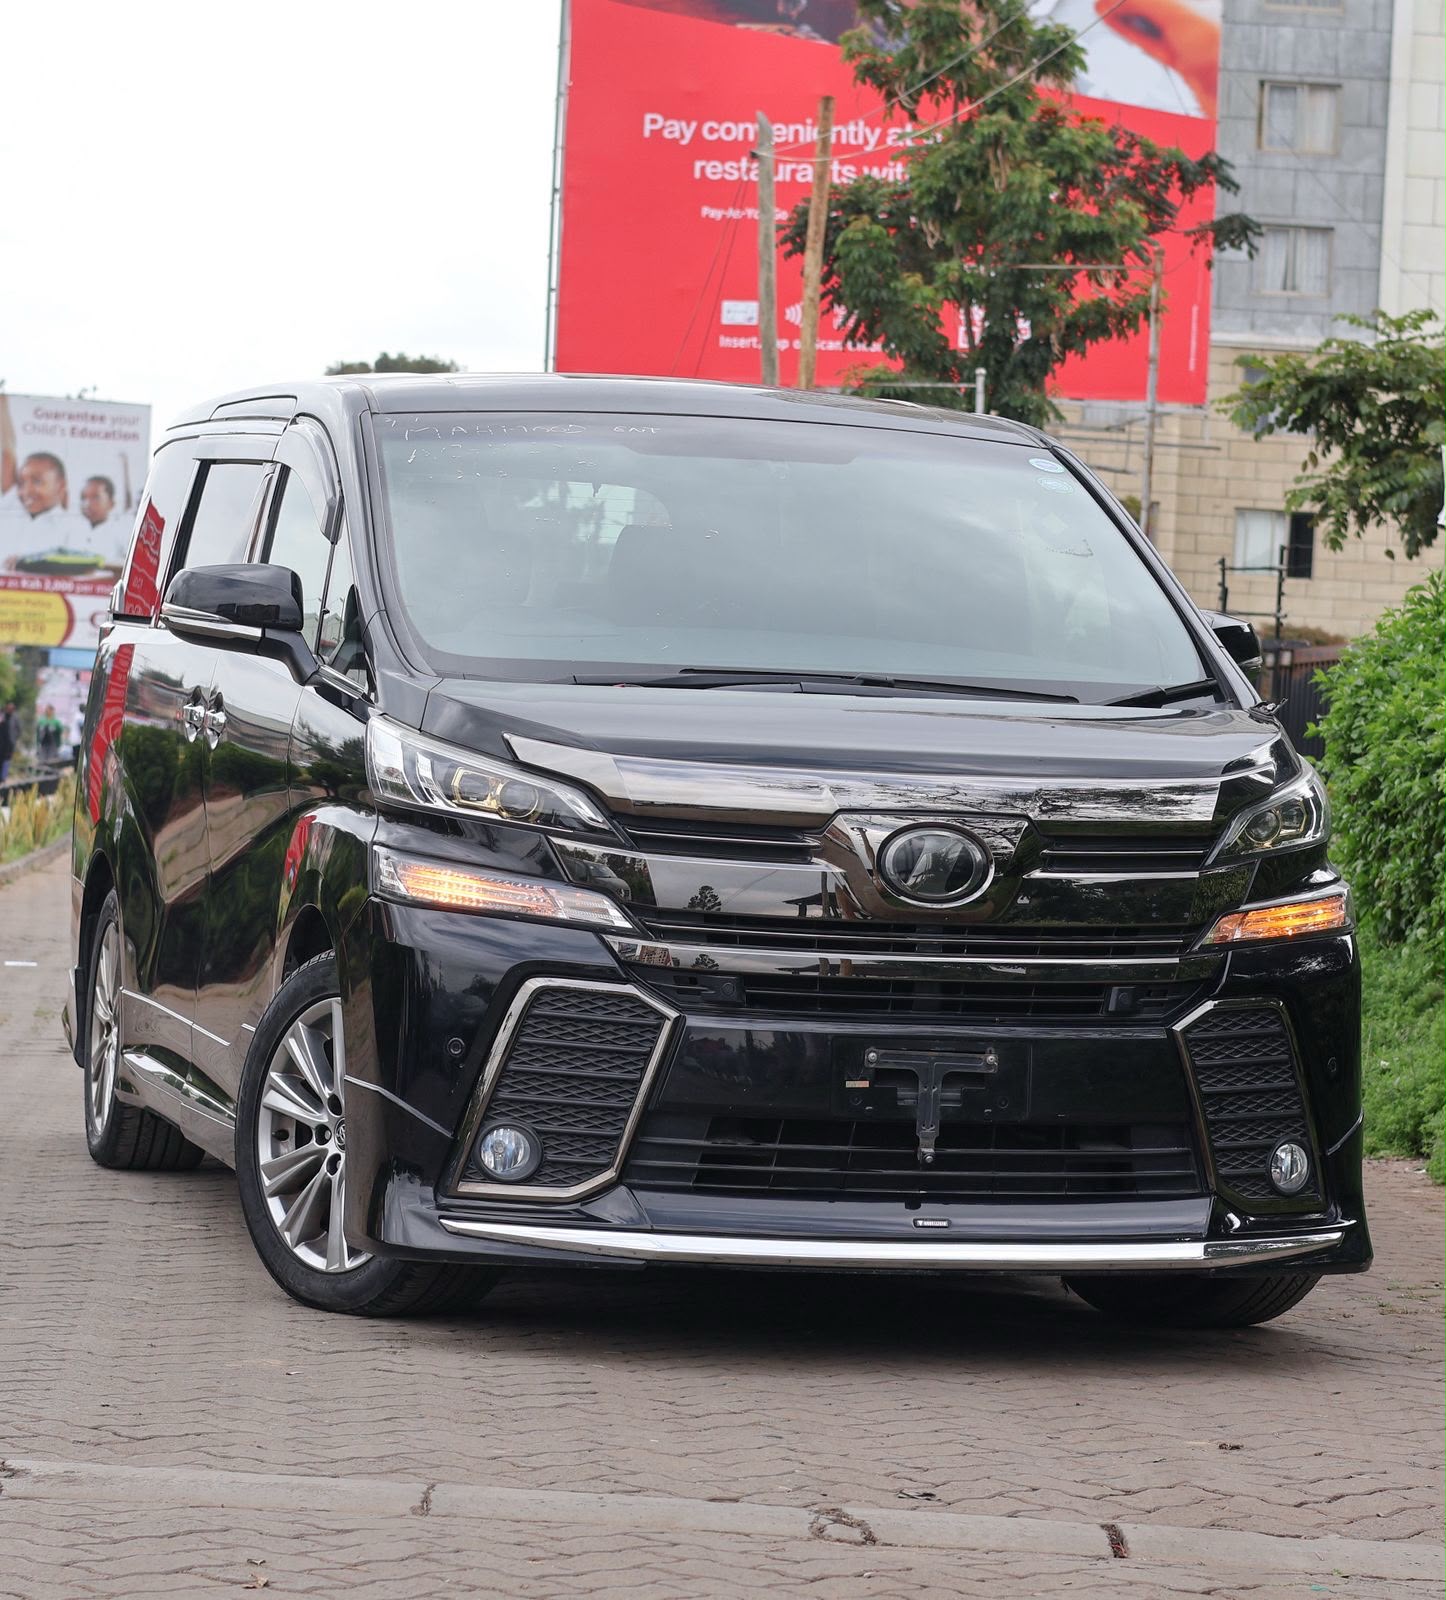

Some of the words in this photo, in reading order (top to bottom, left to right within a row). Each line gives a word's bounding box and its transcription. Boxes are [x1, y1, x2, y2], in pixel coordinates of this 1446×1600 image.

[643, 112, 697, 145] Pay
[33, 407, 106, 422] Guarantee
[70, 426, 140, 441] Education
